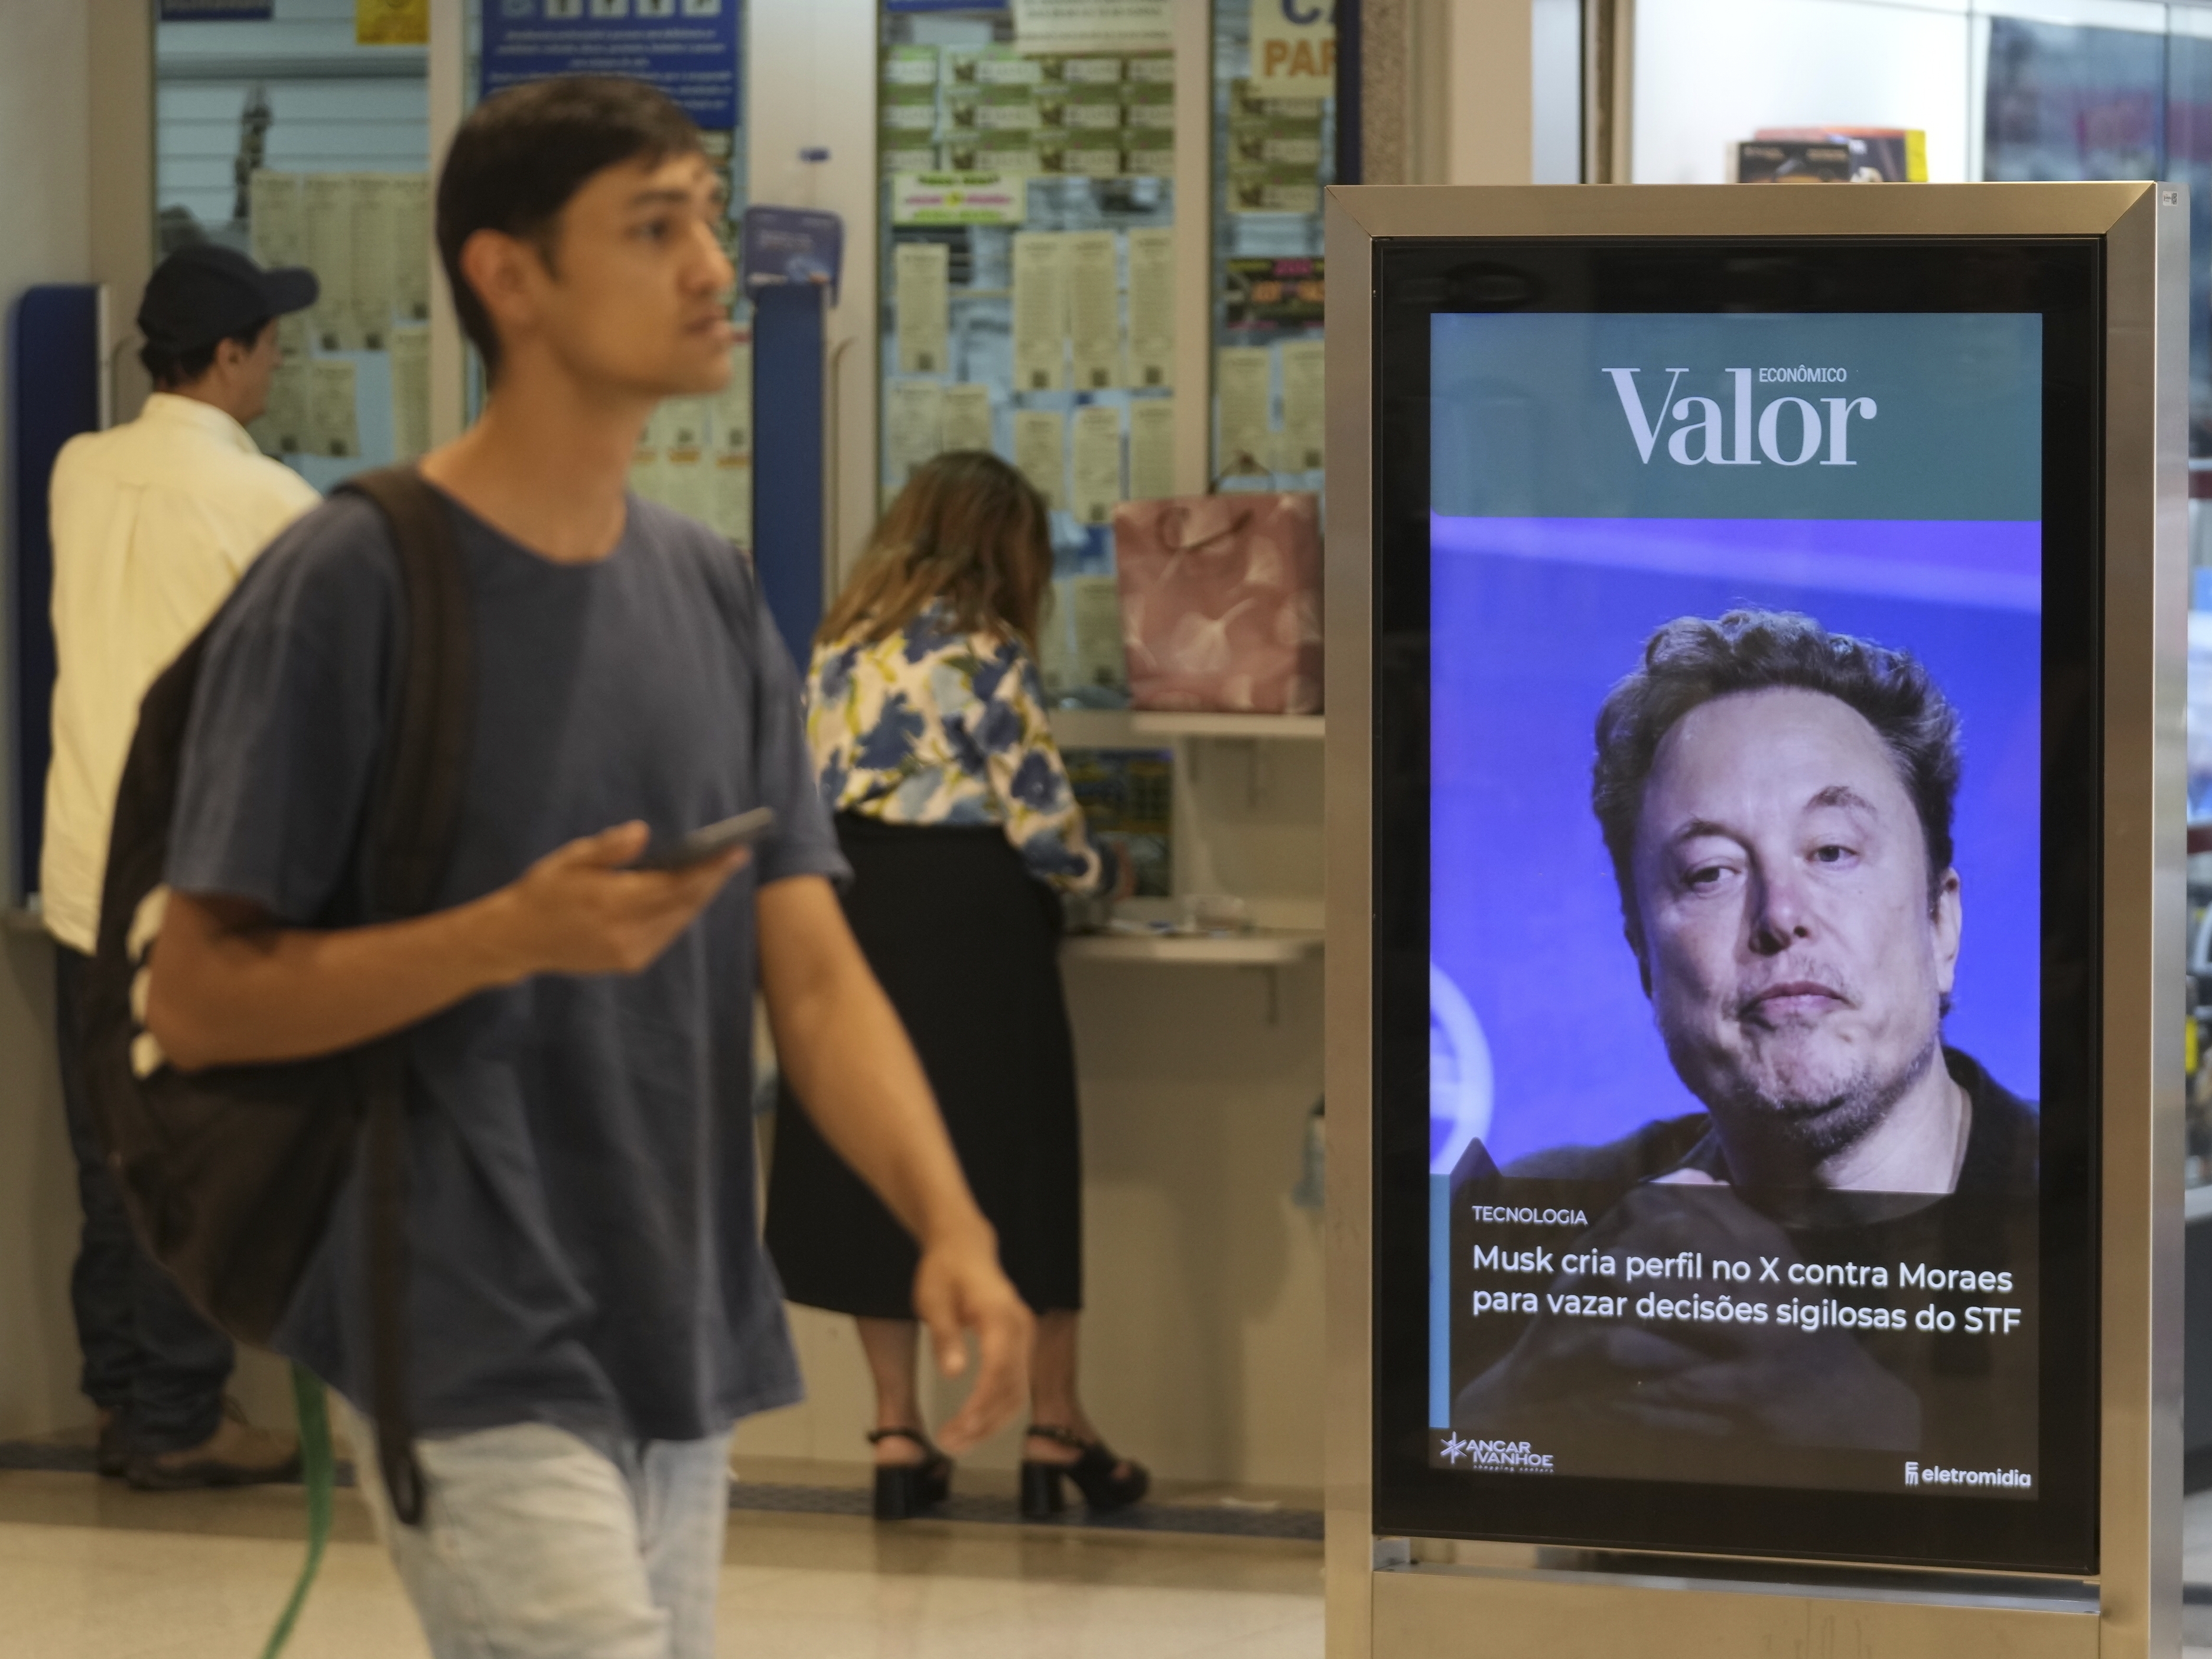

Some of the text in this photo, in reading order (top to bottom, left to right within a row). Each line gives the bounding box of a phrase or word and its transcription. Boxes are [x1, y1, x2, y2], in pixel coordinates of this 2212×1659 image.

[1758, 364, 1847, 383] ECONÔMICO
[1601, 367, 1878, 466] Valor
[1472, 1205, 1589, 1226] TECNOLOGIA
[1473, 1244, 2013, 1294] Musk cria perfil no X contra Moraes
[1472, 1290, 2022, 1335] para vazar decisões sigilosas do STF
[1466, 1439, 1531, 1453] ANCAR
[1472, 1450, 1554, 1468] IVANHOE
[1921, 1465, 2032, 1488] eletromidia
